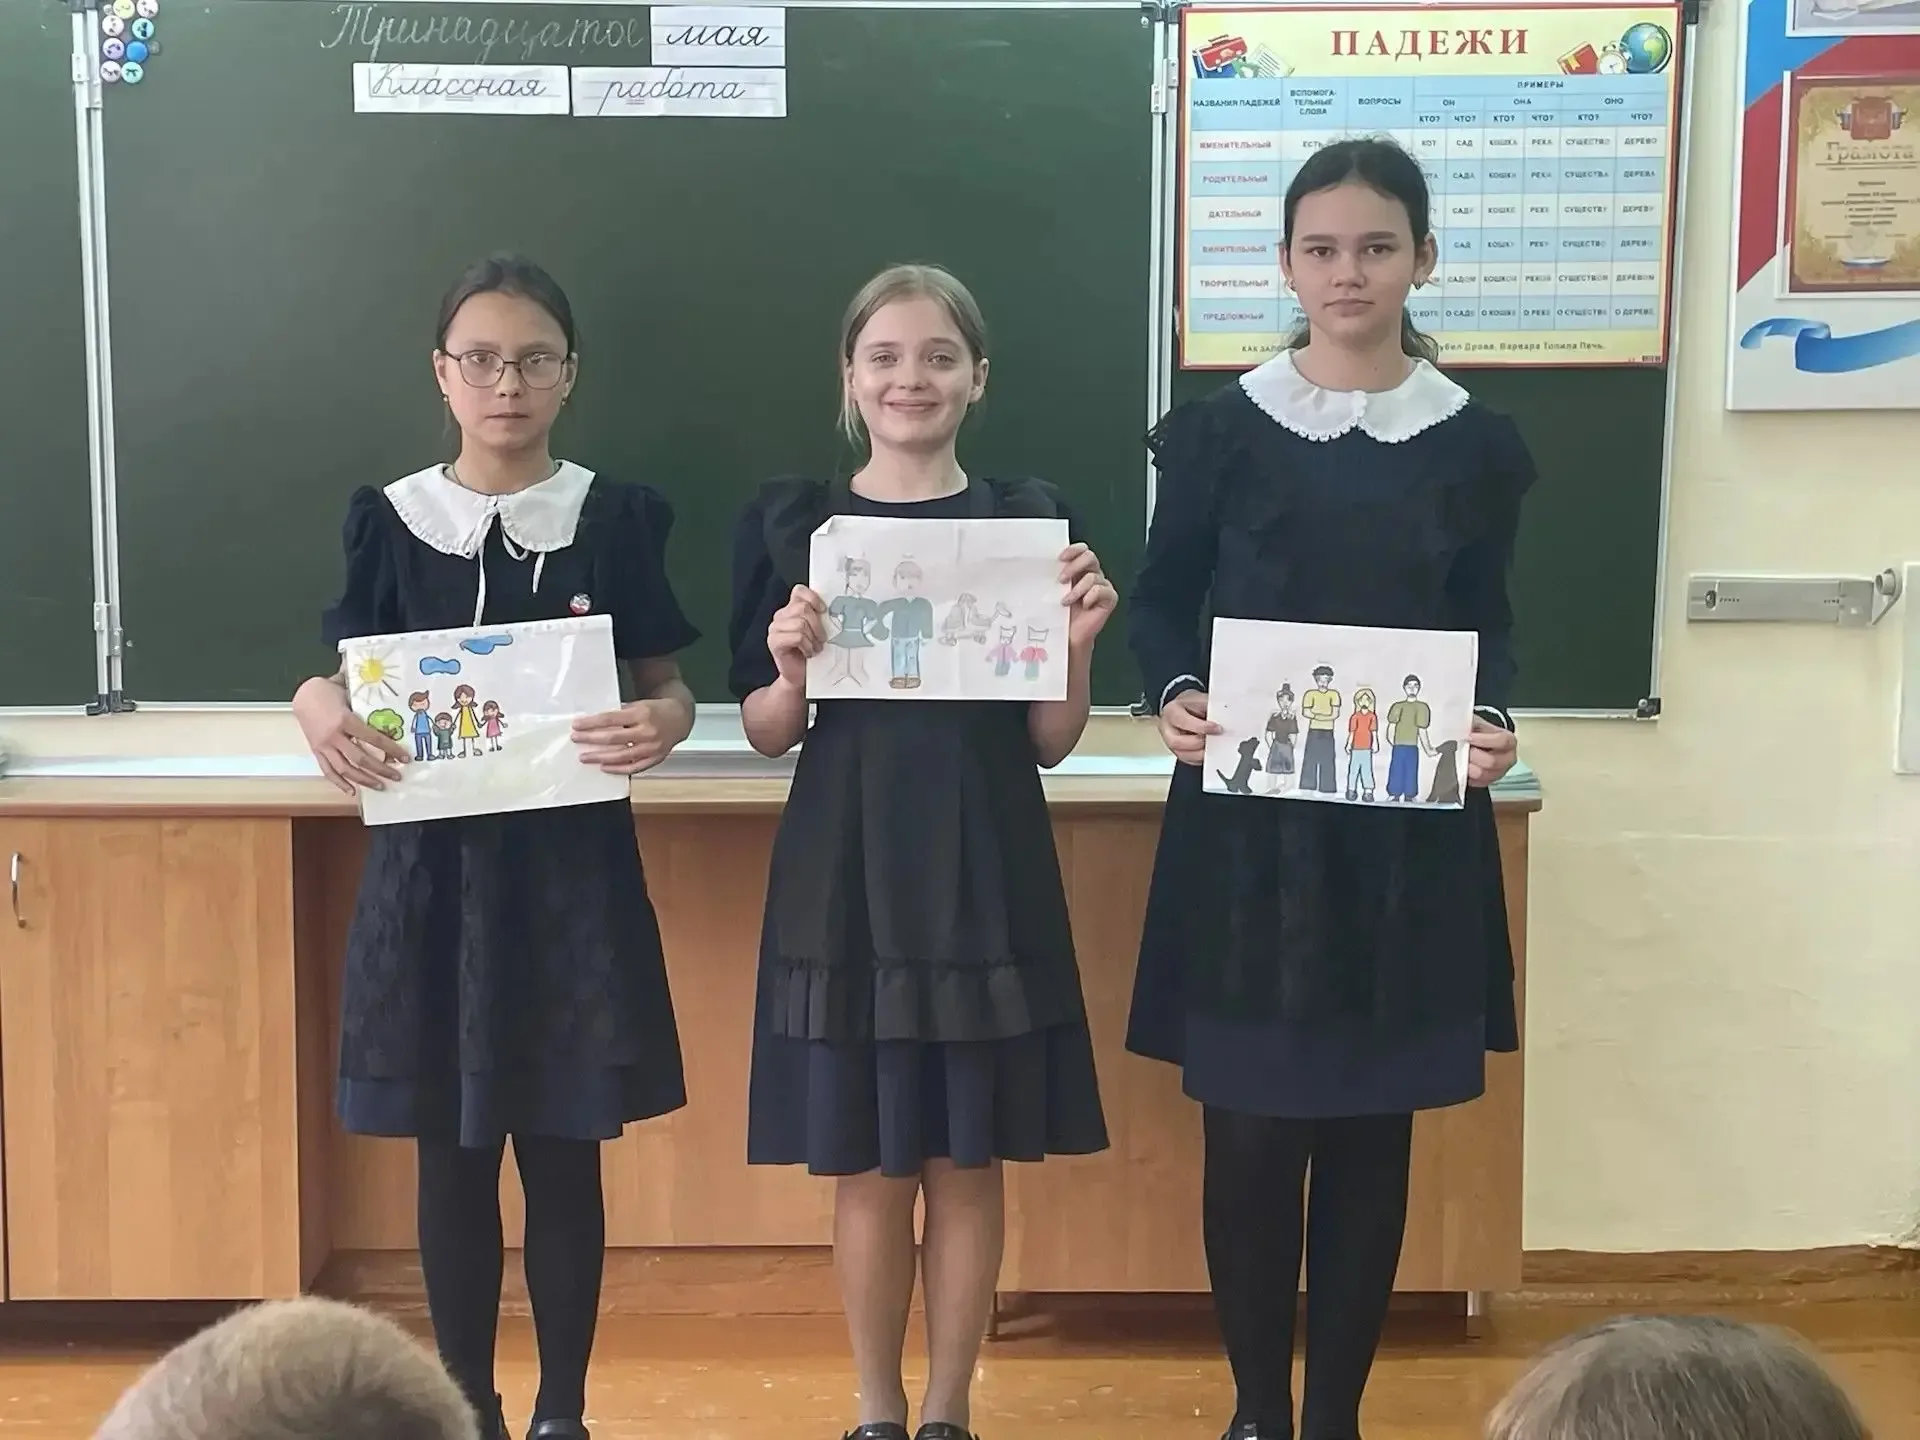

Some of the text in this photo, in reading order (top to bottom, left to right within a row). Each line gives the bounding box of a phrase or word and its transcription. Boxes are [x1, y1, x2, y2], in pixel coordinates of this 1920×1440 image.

[320, 4, 644, 63] Тринадцатое
[666, 26, 770, 46] мая
[1331, 29, 1529, 62] ПАДЕЖИ
[1517, 81, 1564, 89] ПРИМЕРЫ
[1193, 98, 1281, 108] НАЗВАНИЯ ПАДЕЖЕЙ
[1357, 98, 1402, 106] ВОПРОСЫ
[1442, 99, 1456, 107] ОН
[1513, 98, 1532, 106] ОНА
[1604, 98, 1625, 106] ОНО
[1419, 115, 1441, 123] КТО?
[1454, 115, 1477, 123] ЧТО?
[1493, 114, 1515, 123] КТО?
[1531, 114, 1554, 122] ЧТО?
[1577, 114, 1600, 122] КТО?
[1631, 113, 1654, 121] ЧТО?
[1199, 140, 1272, 149] ИМЕНИТЕЛЬНЫЙ
[1421, 139, 1436, 147] КОТ
[1456, 139, 1474, 147] САД
[1565, 138, 1611, 146] СУЩЕСТВО
[1624, 137, 1658, 145] ДЕРЕВО
[1452, 172, 1475, 180] САДА
[1564, 170, 1610, 179] СУЩЕСТВА
[1623, 170, 1656, 178] ДЕРЕВА
[1202, 175, 1268, 184] РОДИТЕЛЬНЫЙ
[1208, 210, 1262, 219] ДАТЕЛЬНЫЙ
[1453, 241, 1472, 249] САД
[1562, 240, 1607, 248] СУЩЕСТВО
[1202, 245, 1267, 254] ВИНИТЕЛЬНЫЙ
[1615, 274, 1655, 282] ДЕРЕВОМ
[1200, 279, 1269, 288] ТВОРИТЕЛЬНЫЙ
[1203, 312, 1264, 321] ПРЕДЛОЖНЫЙ
[1437, 342, 1462, 352] убил
[1500, 342, 1541, 352] Варвара
[1543, 341, 1577, 350] Топила
